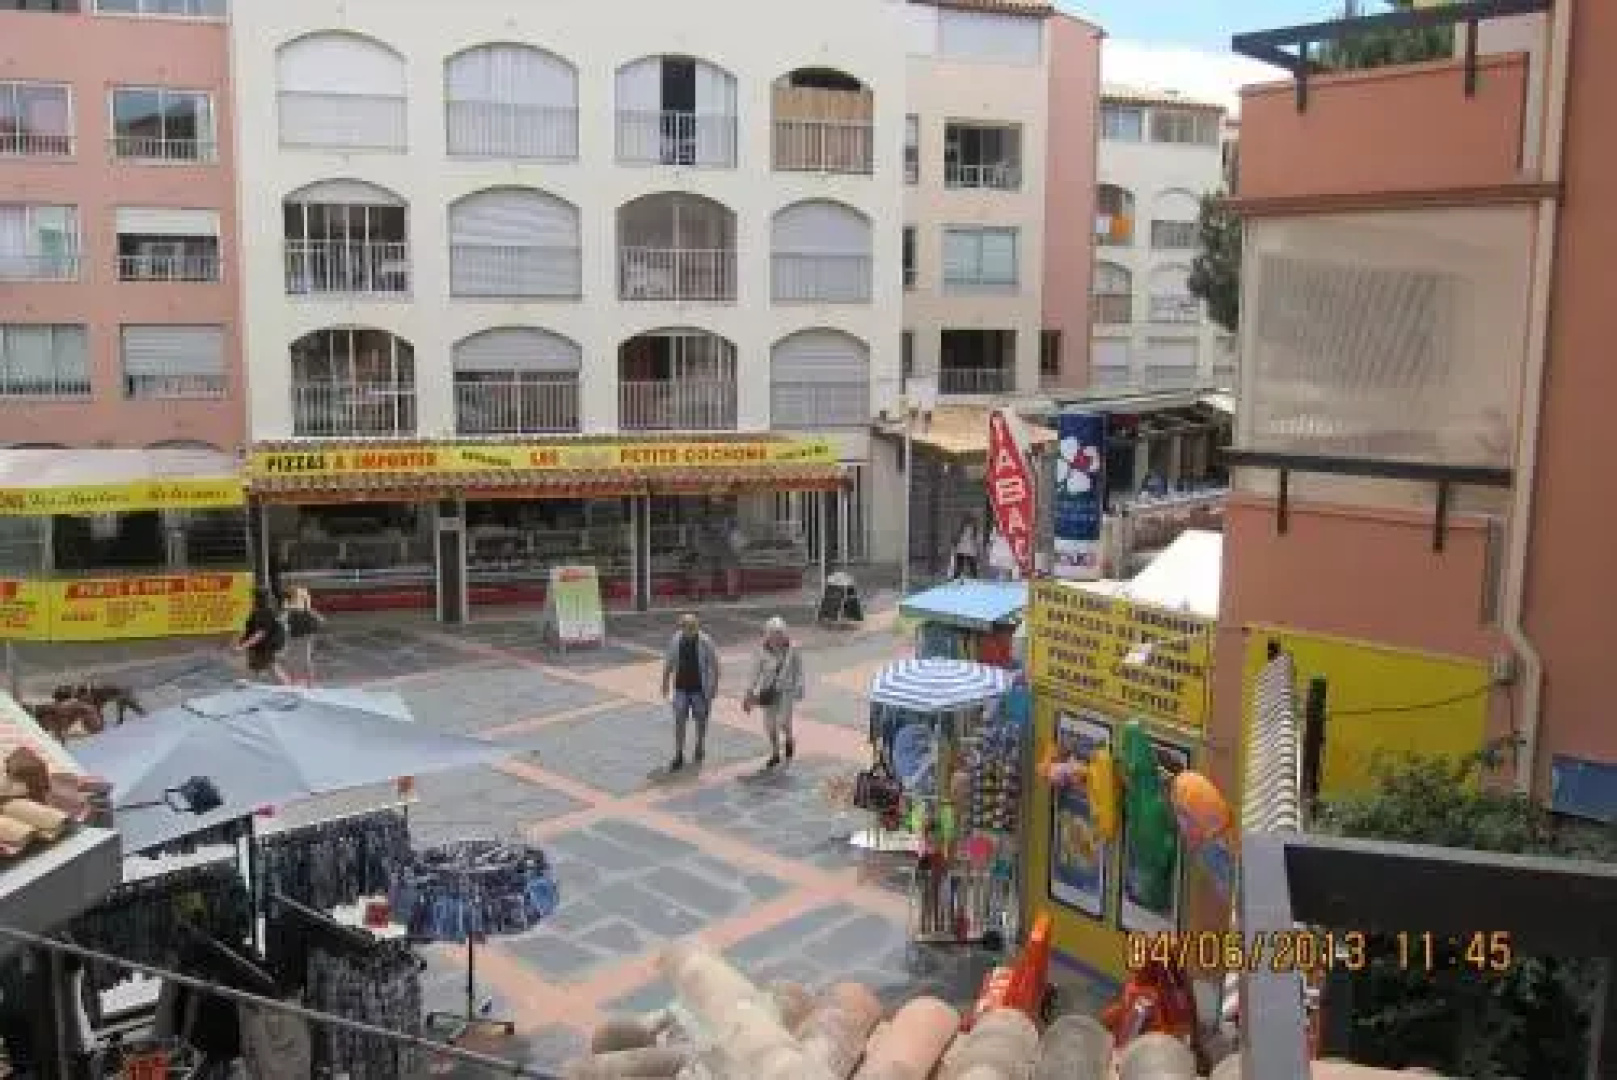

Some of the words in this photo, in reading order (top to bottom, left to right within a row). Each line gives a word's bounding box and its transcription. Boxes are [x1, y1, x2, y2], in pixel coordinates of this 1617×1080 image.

[266, 453, 326, 472] PIZZAS
[620, 446, 679, 463] PETITS
[684, 444, 767, 462] COCHONS
